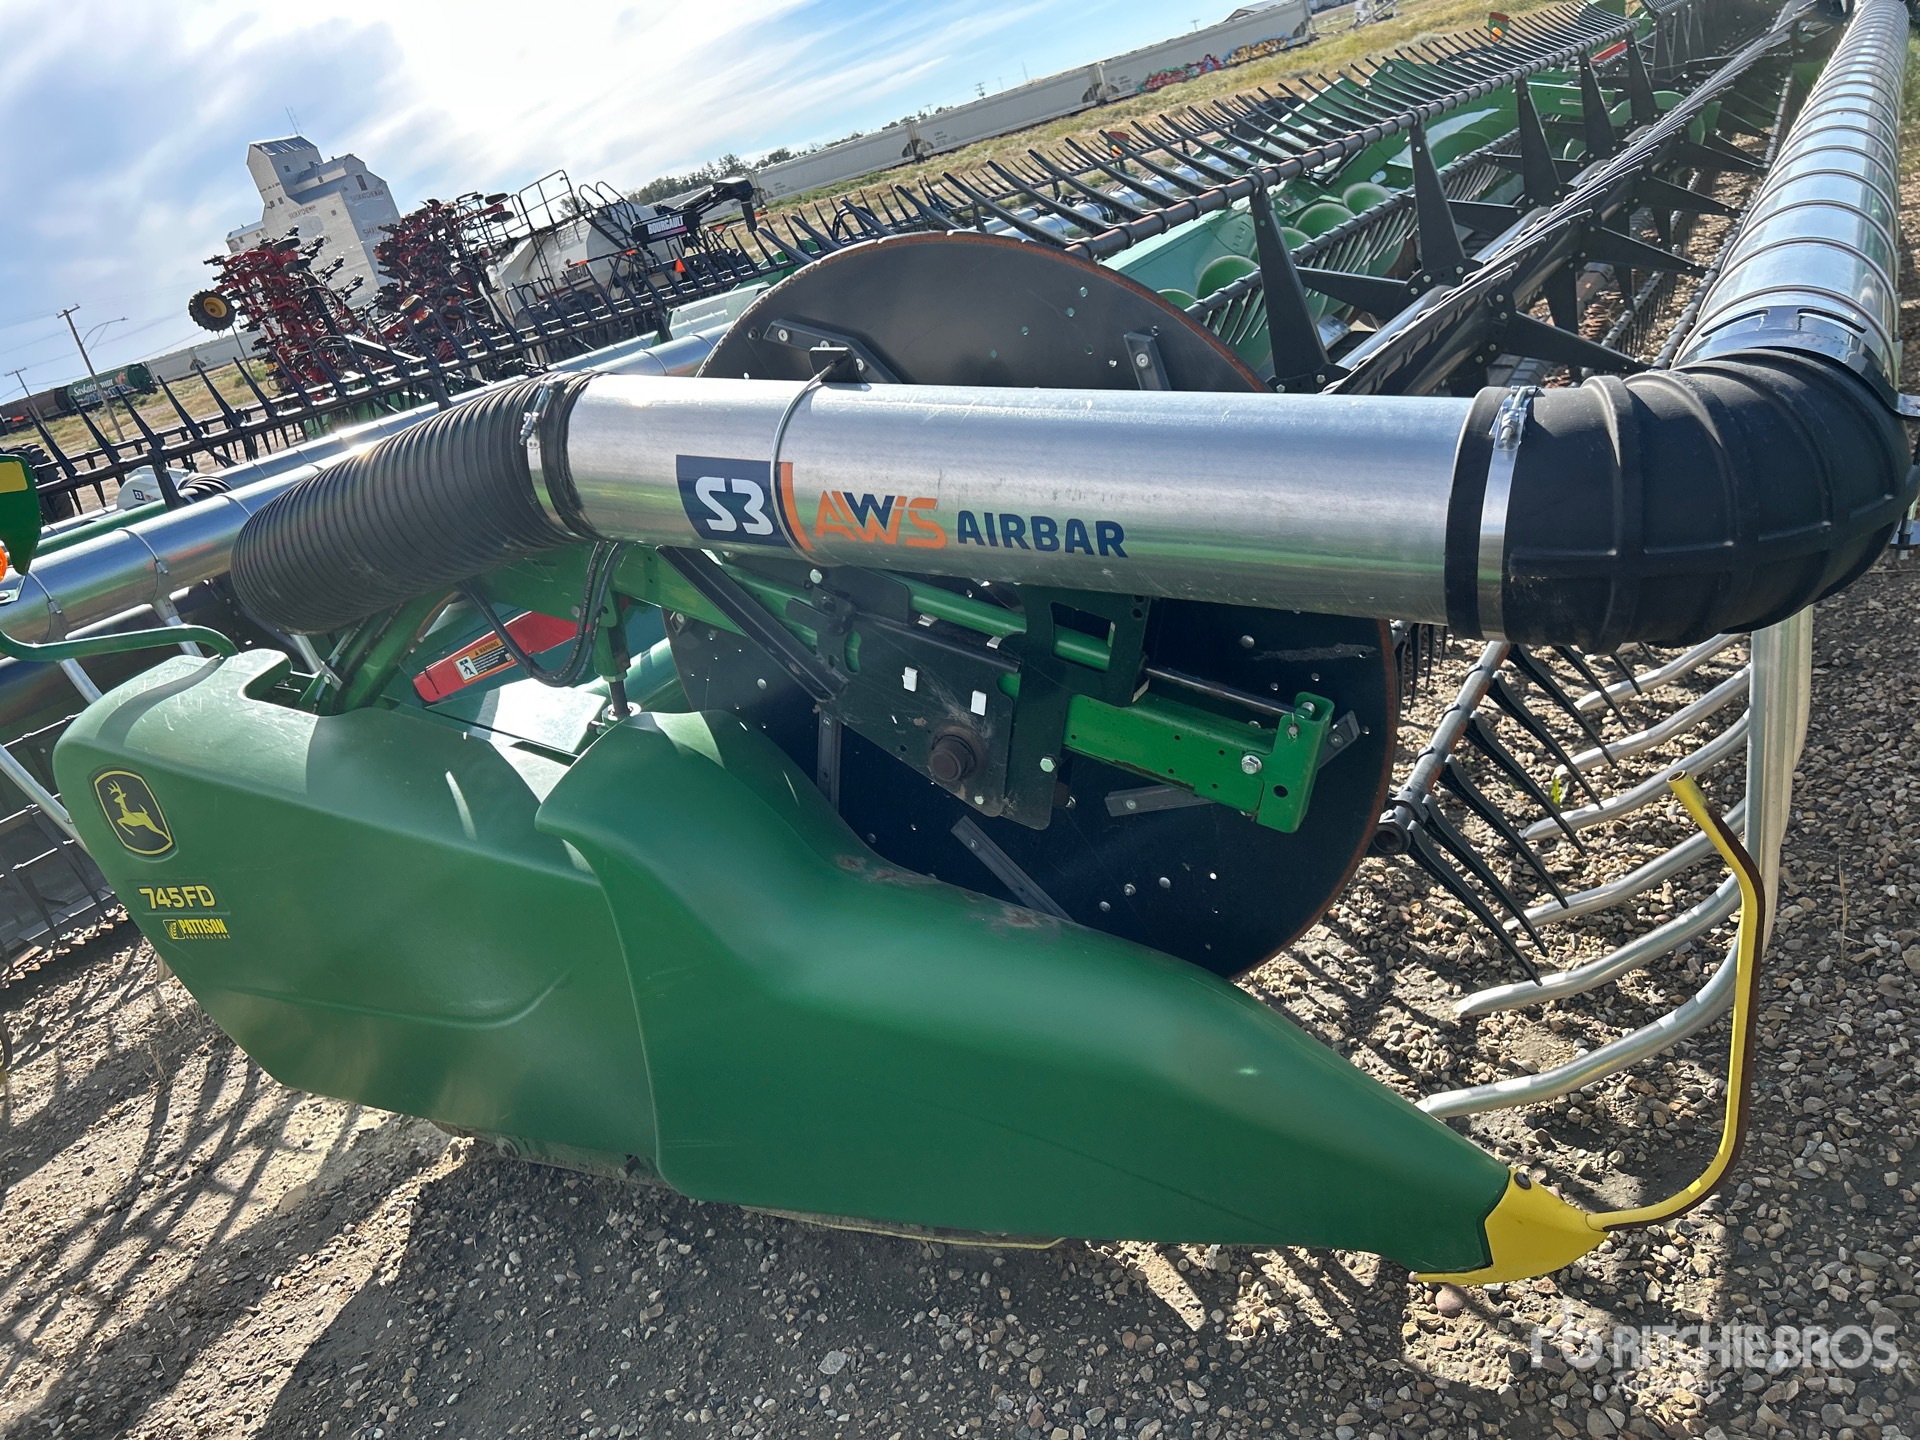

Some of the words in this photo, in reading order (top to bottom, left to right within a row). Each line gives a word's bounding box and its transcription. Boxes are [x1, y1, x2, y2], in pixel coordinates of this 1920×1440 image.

[647, 215, 684, 235] BOURGAULT
[694, 476, 774, 536] S3
[957, 510, 1128, 558] AIRBAR
[138, 885, 217, 910] 745FD
[177, 918, 228, 934] PATTISON
